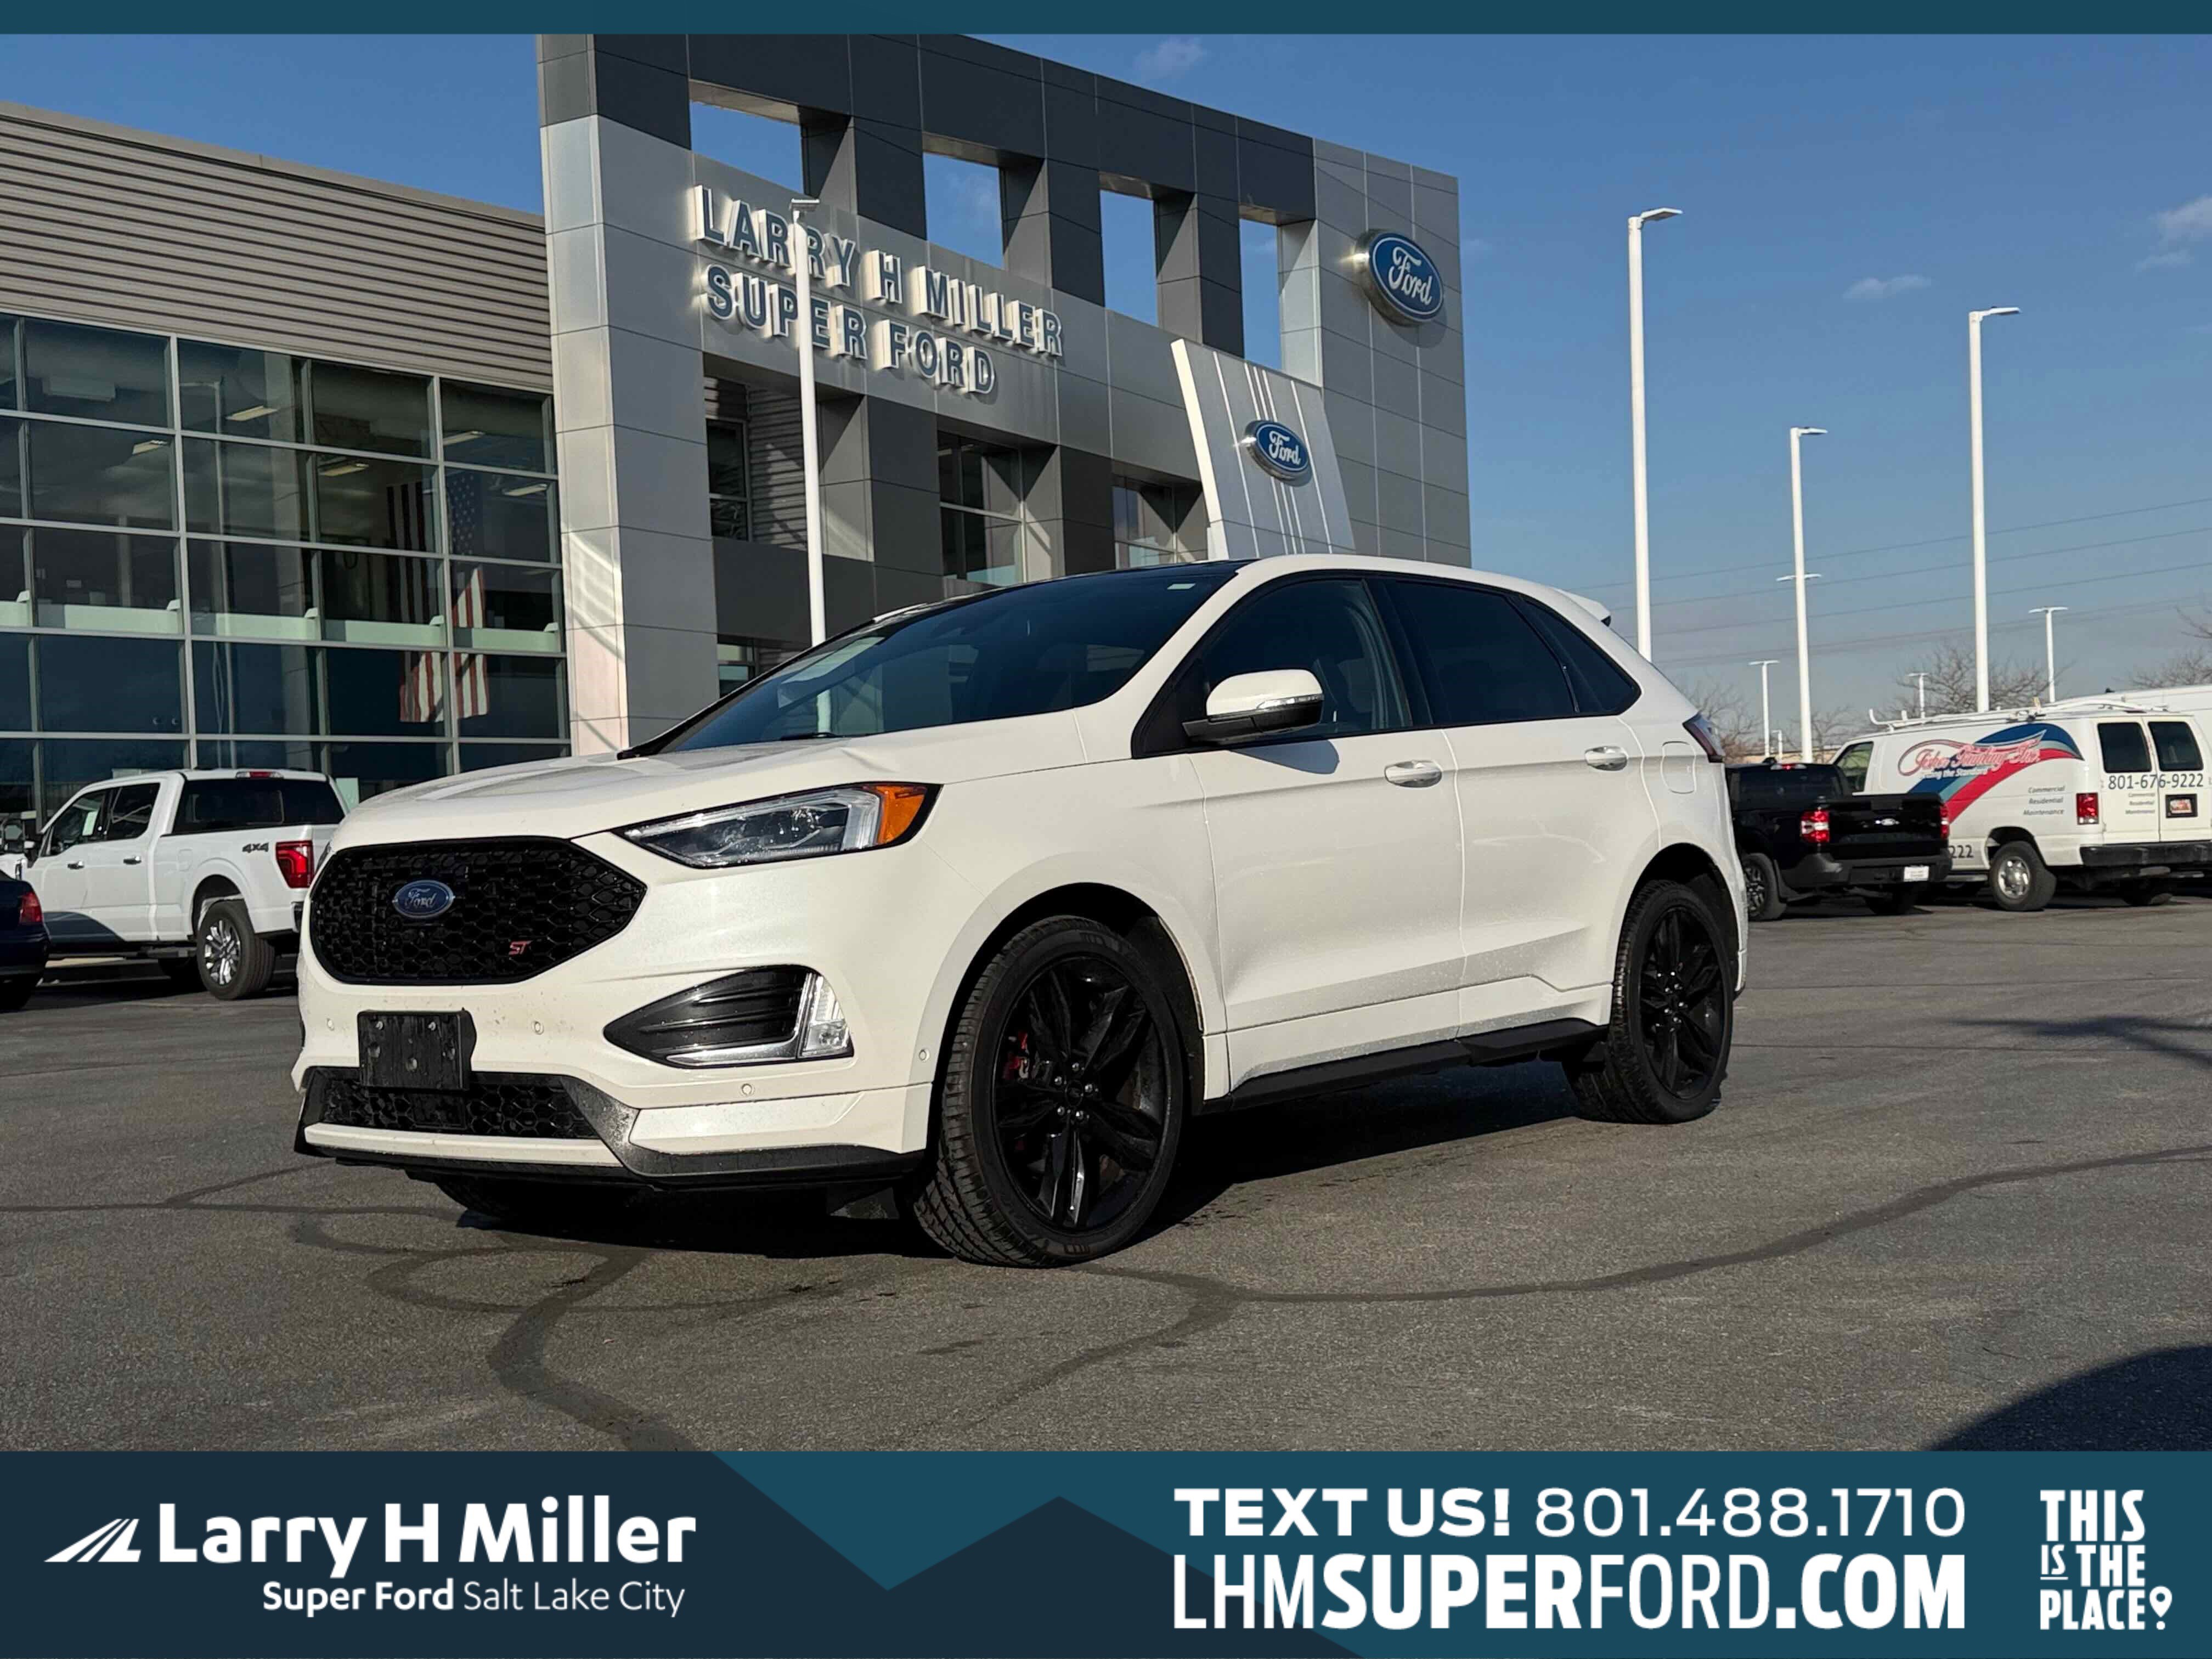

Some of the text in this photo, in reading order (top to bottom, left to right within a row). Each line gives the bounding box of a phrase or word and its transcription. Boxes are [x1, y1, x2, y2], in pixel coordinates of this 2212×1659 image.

[694, 185, 1062, 357] LARRY H MILLER
[1387, 245, 1433, 306] Ford
[705, 263, 995, 394] SUPER FORD
[1268, 430, 1302, 465] Ford
[2108, 773, 2204, 789] 801-676-9222
[404, 888, 437, 910] Ford
[509, 940, 532, 956] ST
